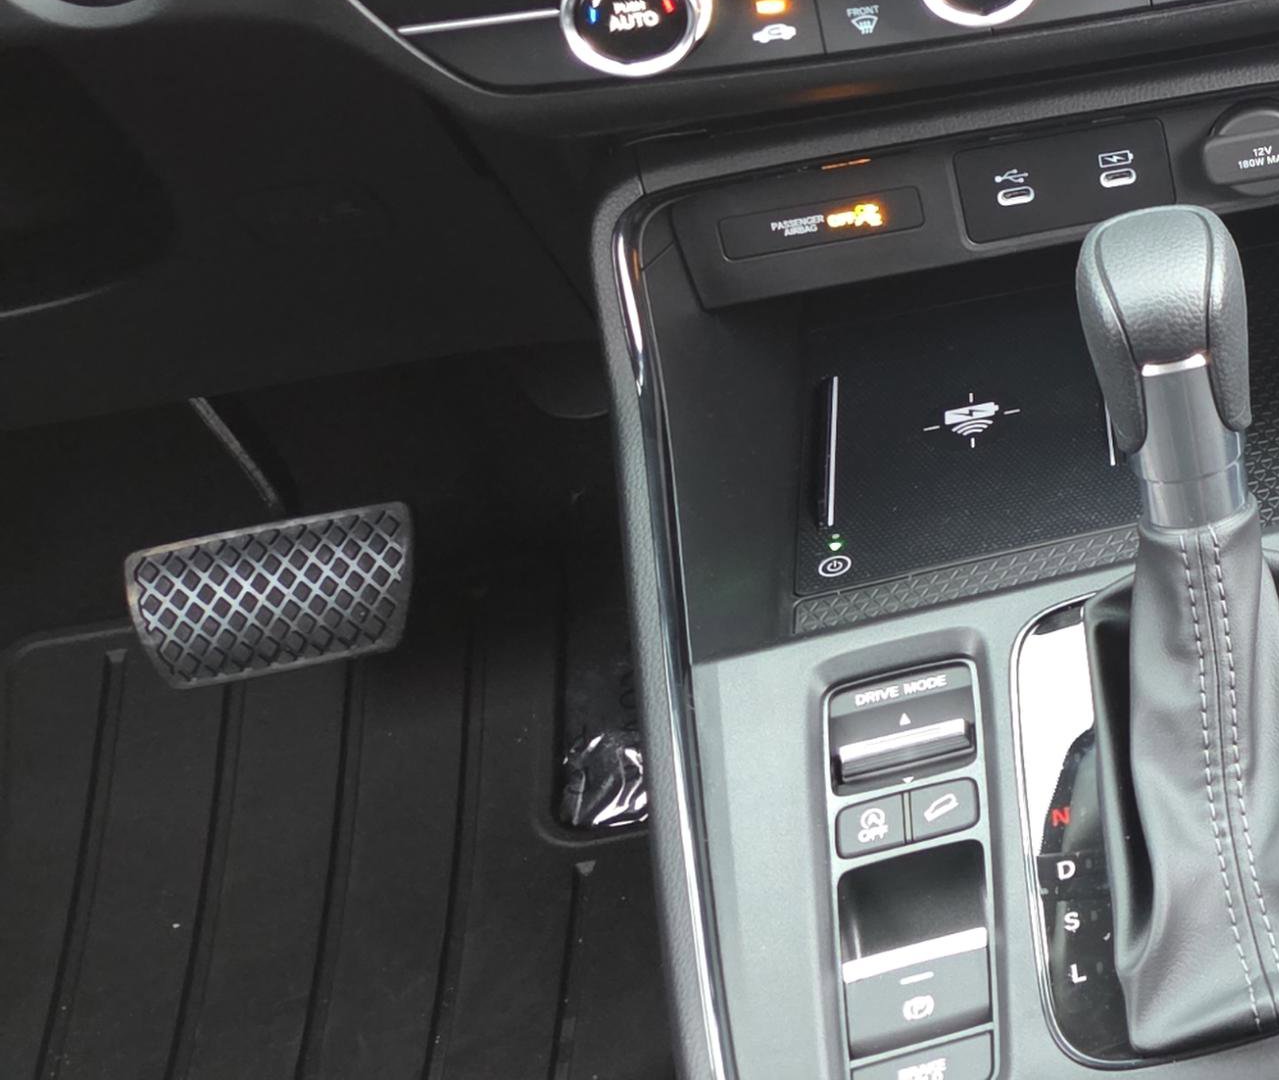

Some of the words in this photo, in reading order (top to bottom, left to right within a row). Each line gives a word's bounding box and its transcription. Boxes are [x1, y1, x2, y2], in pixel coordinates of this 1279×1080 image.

[609, 10, 660, 32] AUTO
[846, 5, 879, 18] FRONT
[1253, 145, 1272, 157] 12V
[1238, 158, 1264, 170] 180W
[770, 215, 824, 231] PASSENGER
[784, 224, 818, 237] AIRBAG
[855, 685, 899, 707] DRIVE
[903, 674, 947, 696] MODE
[1052, 806, 1071, 827] N
[858, 824, 888, 843] OFF
[1056, 859, 1076, 881] D
[1064, 911, 1081, 932] S
[1070, 963, 1087, 984] L
